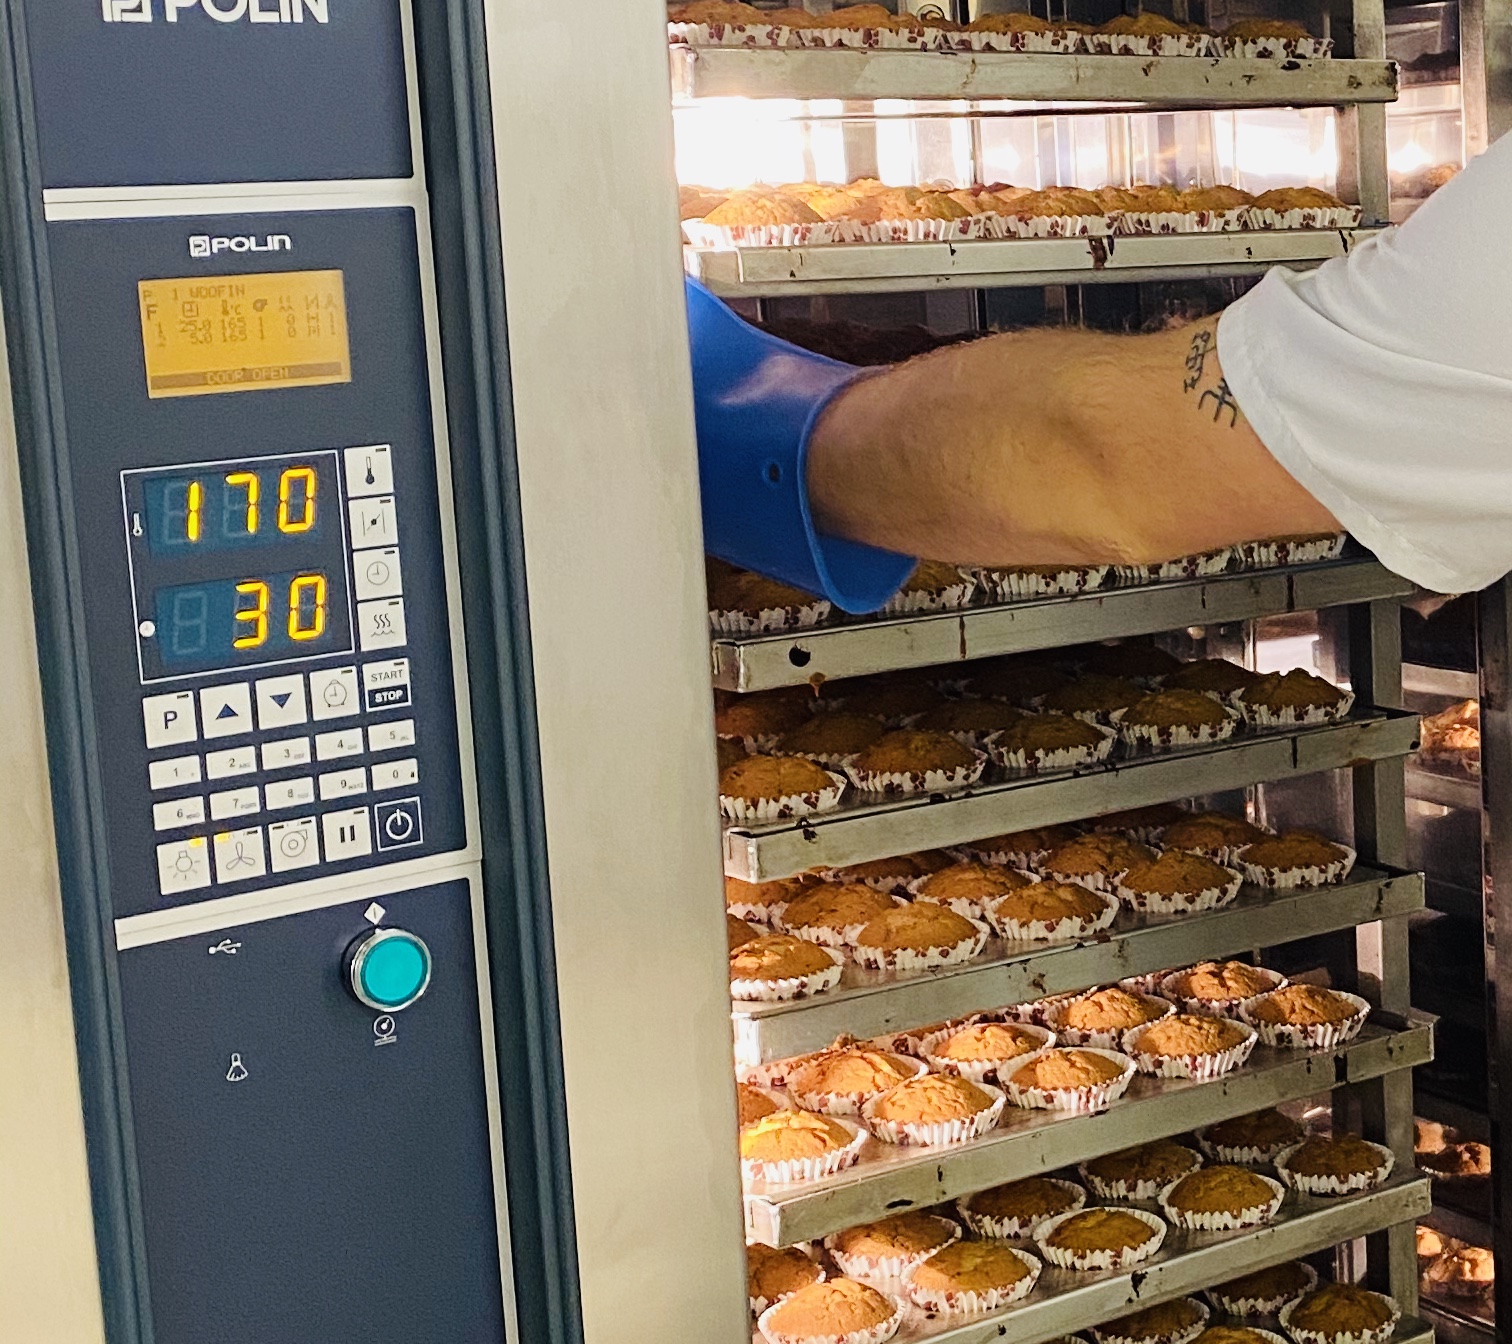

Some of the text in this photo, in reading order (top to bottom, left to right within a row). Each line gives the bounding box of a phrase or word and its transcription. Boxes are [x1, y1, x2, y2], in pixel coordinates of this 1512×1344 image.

[206, 367, 289, 385] DOOR OPEN
[185, 465, 317, 543] 170
[232, 572, 327, 650] 30
[370, 669, 403, 683] START
[374, 689, 404, 703] STOP
[164, 710, 178, 730] P
[389, 730, 396, 740] 5
[337, 739, 344, 749] 4
[228, 758, 236, 768] 2
[232, 798, 239, 809] 7
[176, 808, 183, 818] 6
